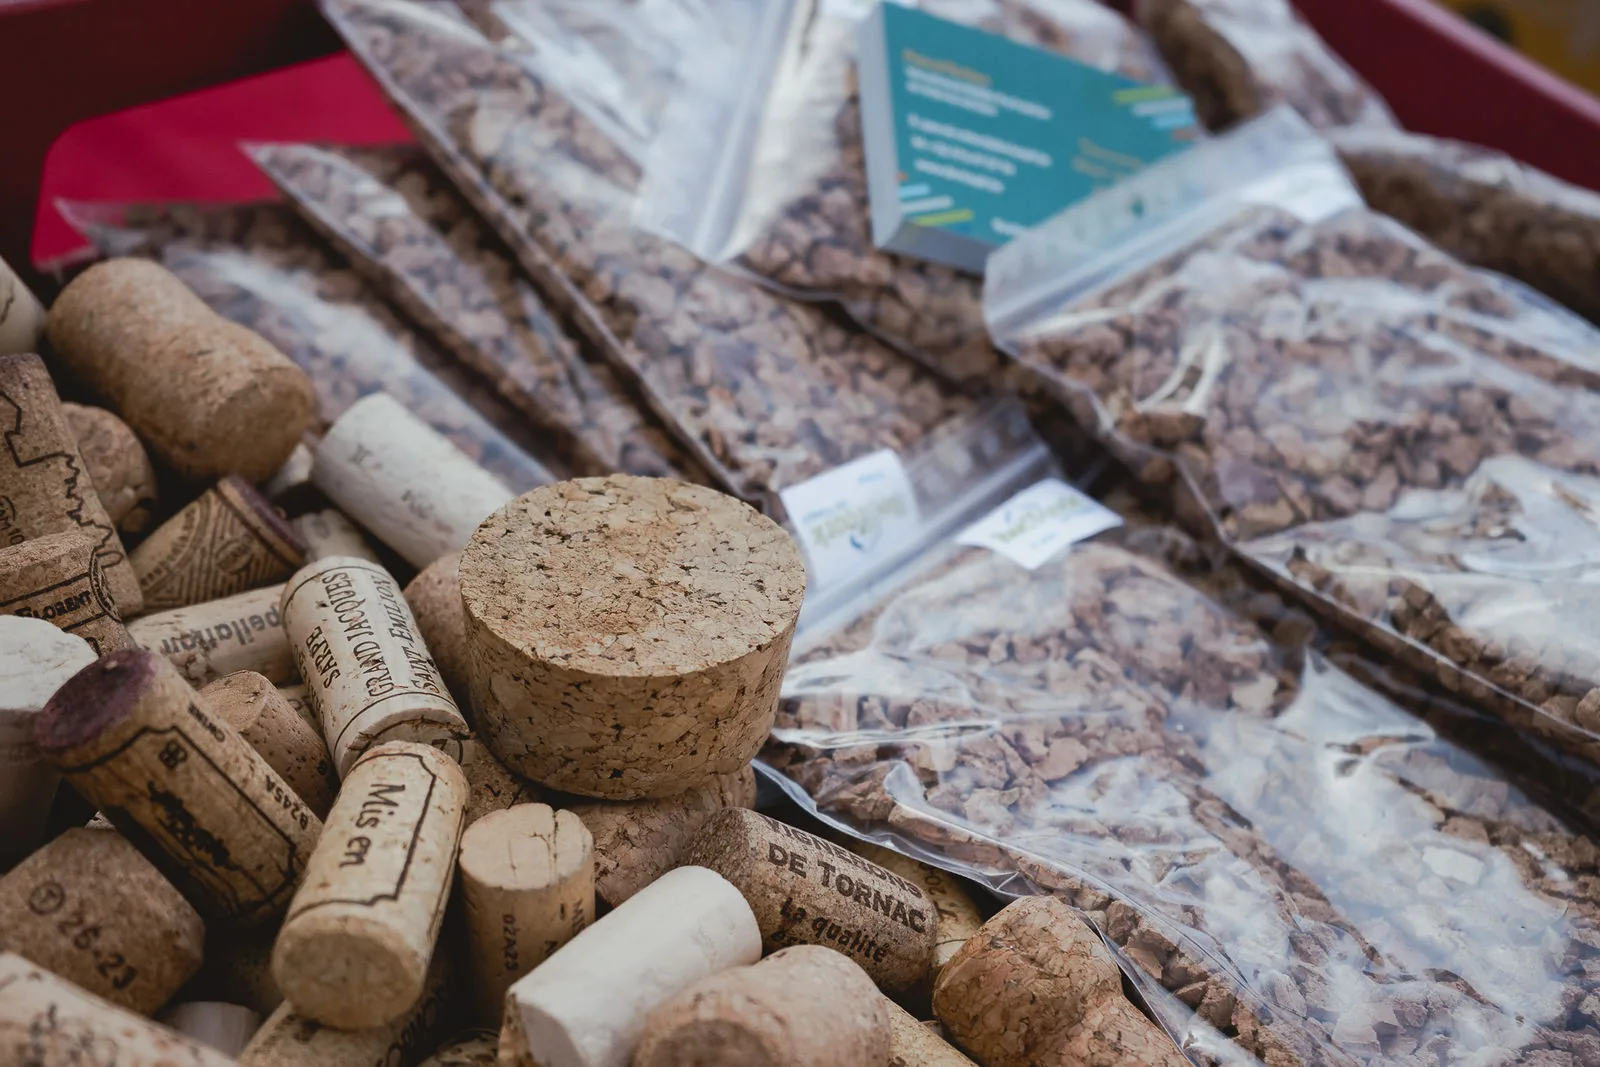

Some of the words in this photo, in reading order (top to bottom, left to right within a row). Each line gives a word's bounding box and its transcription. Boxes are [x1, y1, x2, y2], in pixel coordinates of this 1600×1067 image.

[321, 572, 376, 642] JACQUES
[306, 626, 341, 689] SARPE
[353, 641, 395, 697] GRAND
[355, 783, 406, 829] Mis
[338, 835, 372, 869] en
[758, 813, 923, 899] VIGNERONS
[767, 842, 808, 879] DE
[816, 859, 927, 934] TORNAC
[811, 916, 891, 964] qualité
